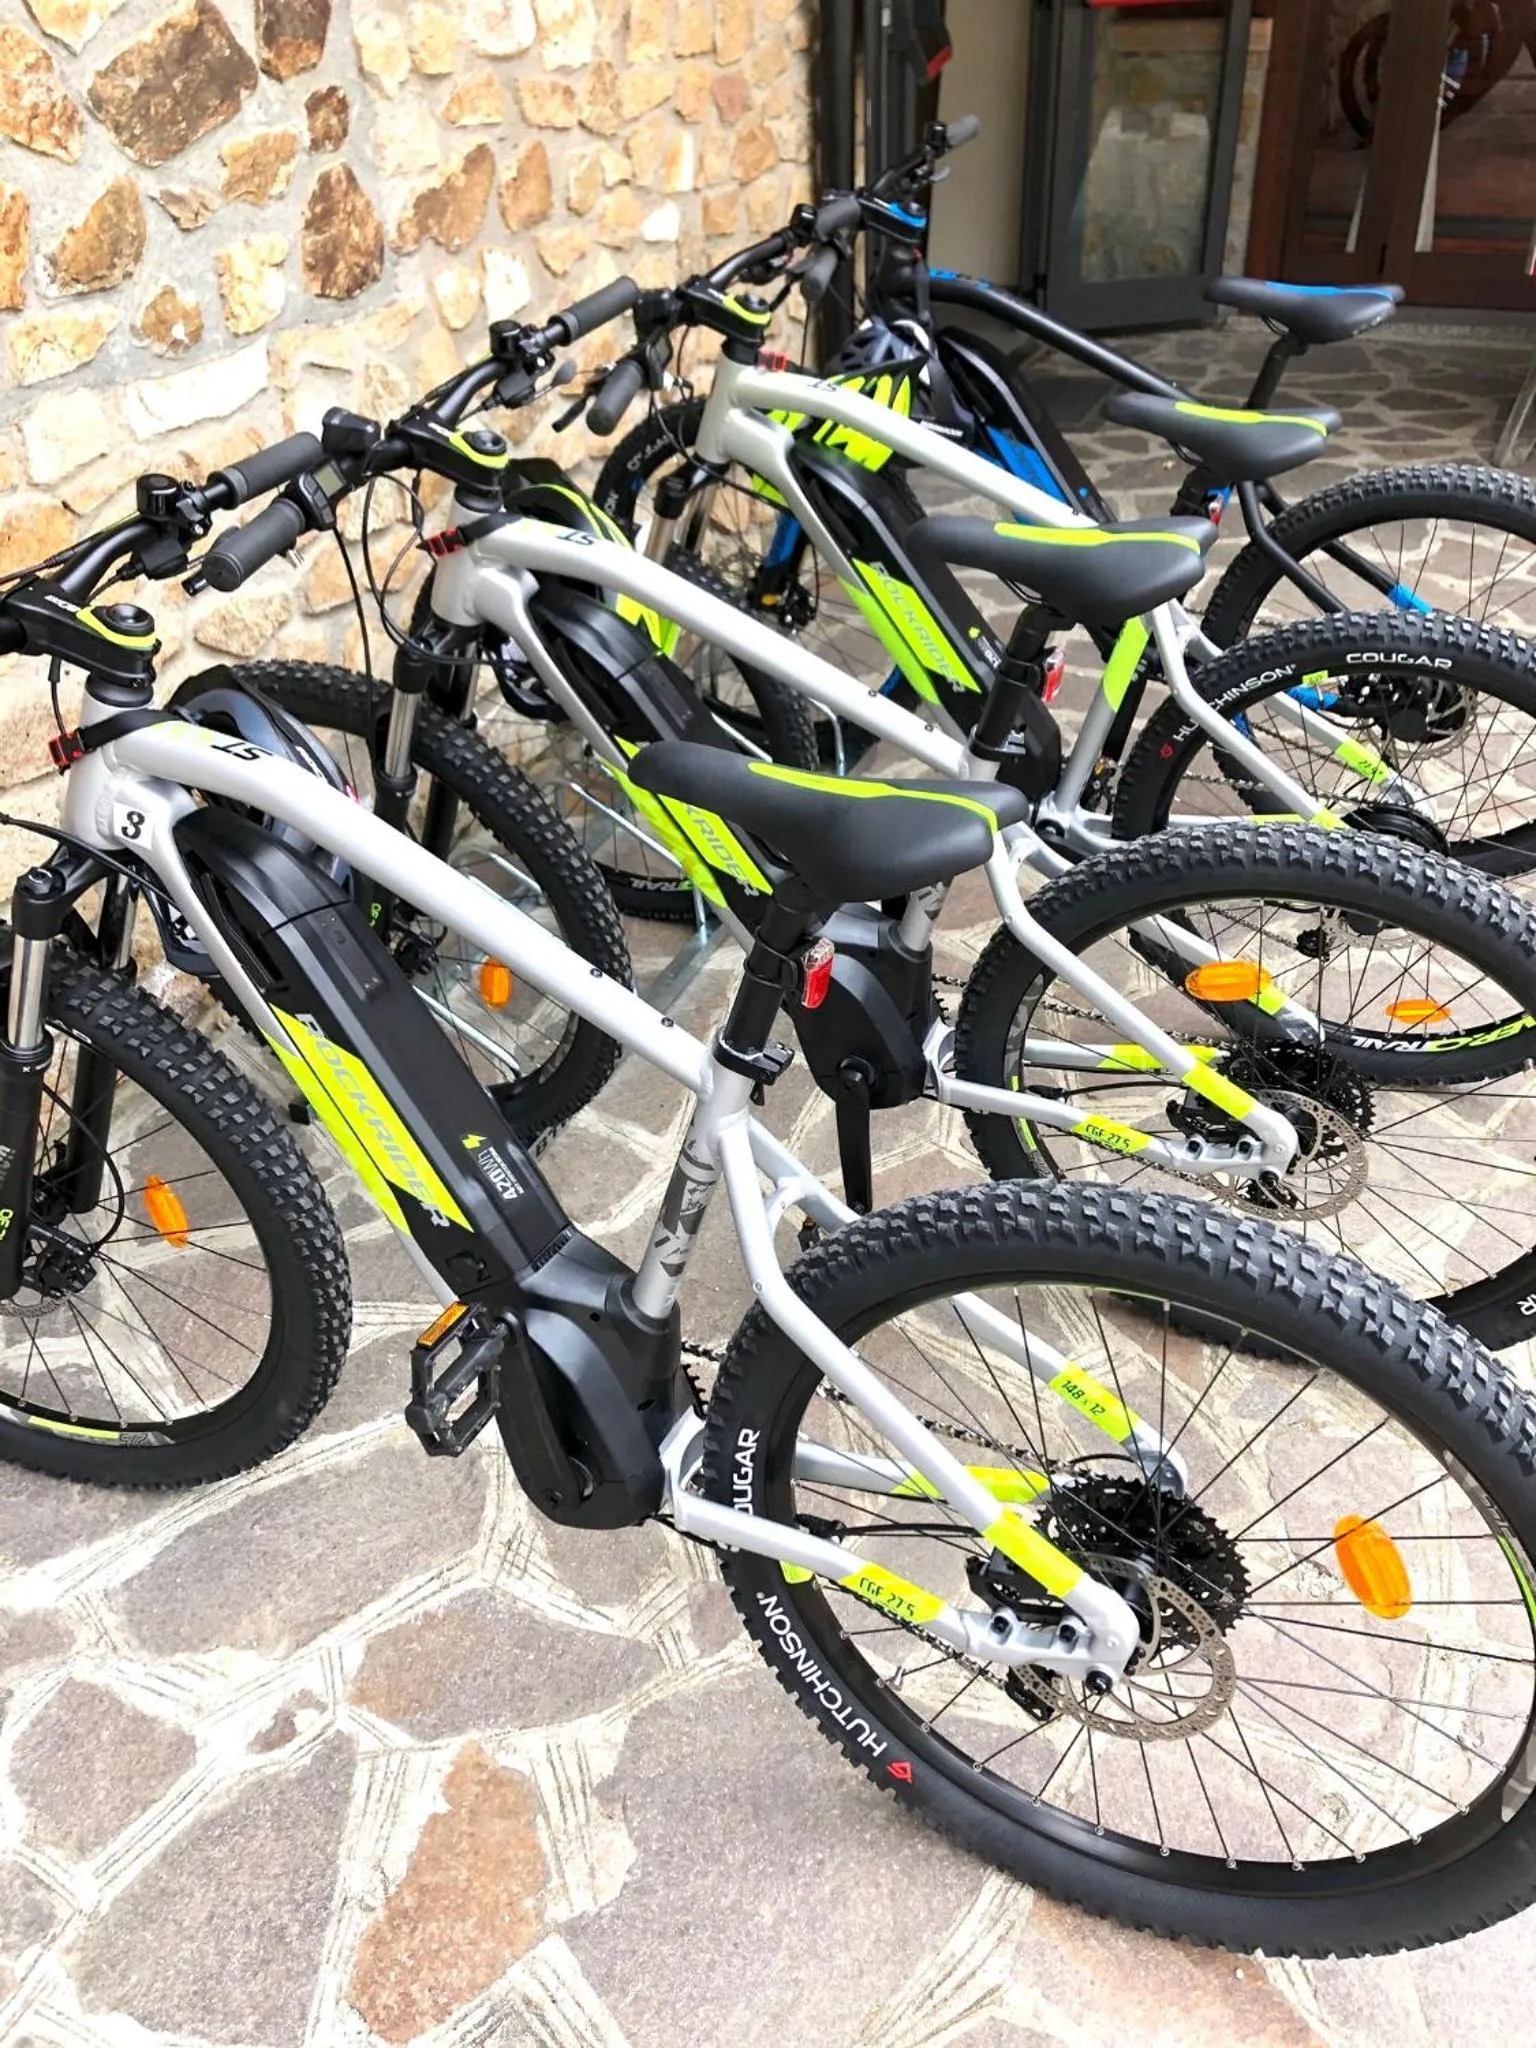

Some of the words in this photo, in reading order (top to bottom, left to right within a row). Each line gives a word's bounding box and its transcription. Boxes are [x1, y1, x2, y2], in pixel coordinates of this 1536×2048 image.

[1346, 652, 1453, 670] COUGAR
[1172, 664, 1295, 742] HUCHINSON
[121, 810, 146, 840] 3
[295, 1013, 450, 1228] ROCKRIDER
[1061, 1380, 1085, 1400] 148
[1090, 1402, 1107, 1416] 12
[732, 1428, 760, 1516] OUGAR
